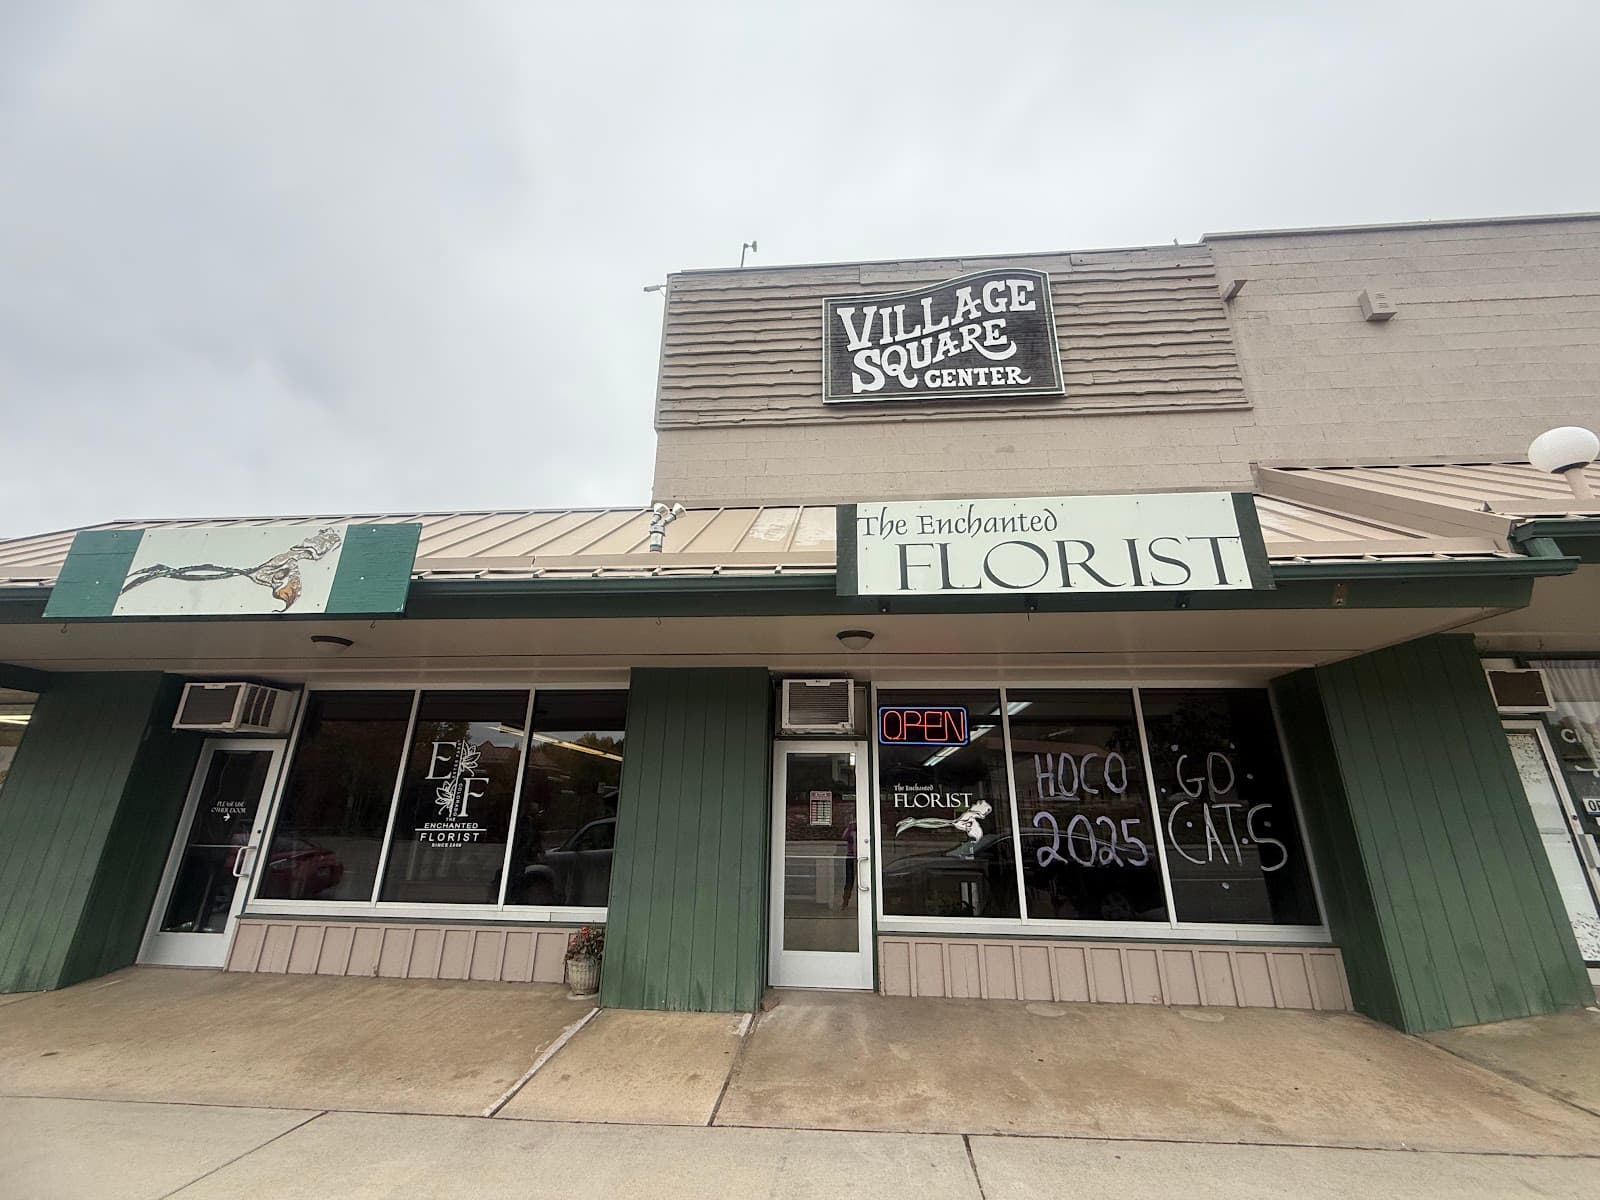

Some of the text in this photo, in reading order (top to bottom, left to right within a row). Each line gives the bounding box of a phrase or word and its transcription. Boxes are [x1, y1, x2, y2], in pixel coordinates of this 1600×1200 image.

[837, 279, 1036, 351] VILLAGE
[852, 318, 1017, 393] SQUARE
[924, 366, 1031, 388] CENTER
[857, 504, 1058, 540] The Enchanted
[895, 535, 1240, 591] FLORIST
[883, 710, 965, 742] OPEN
[1034, 752, 1127, 799] HOCO
[1176, 752, 1235, 797] GO
[894, 793, 973, 808] FLORIST
[420, 832, 480, 842] FLORIST
[1033, 811, 1149, 868] 2025
[1168, 801, 1288, 872] CATS
